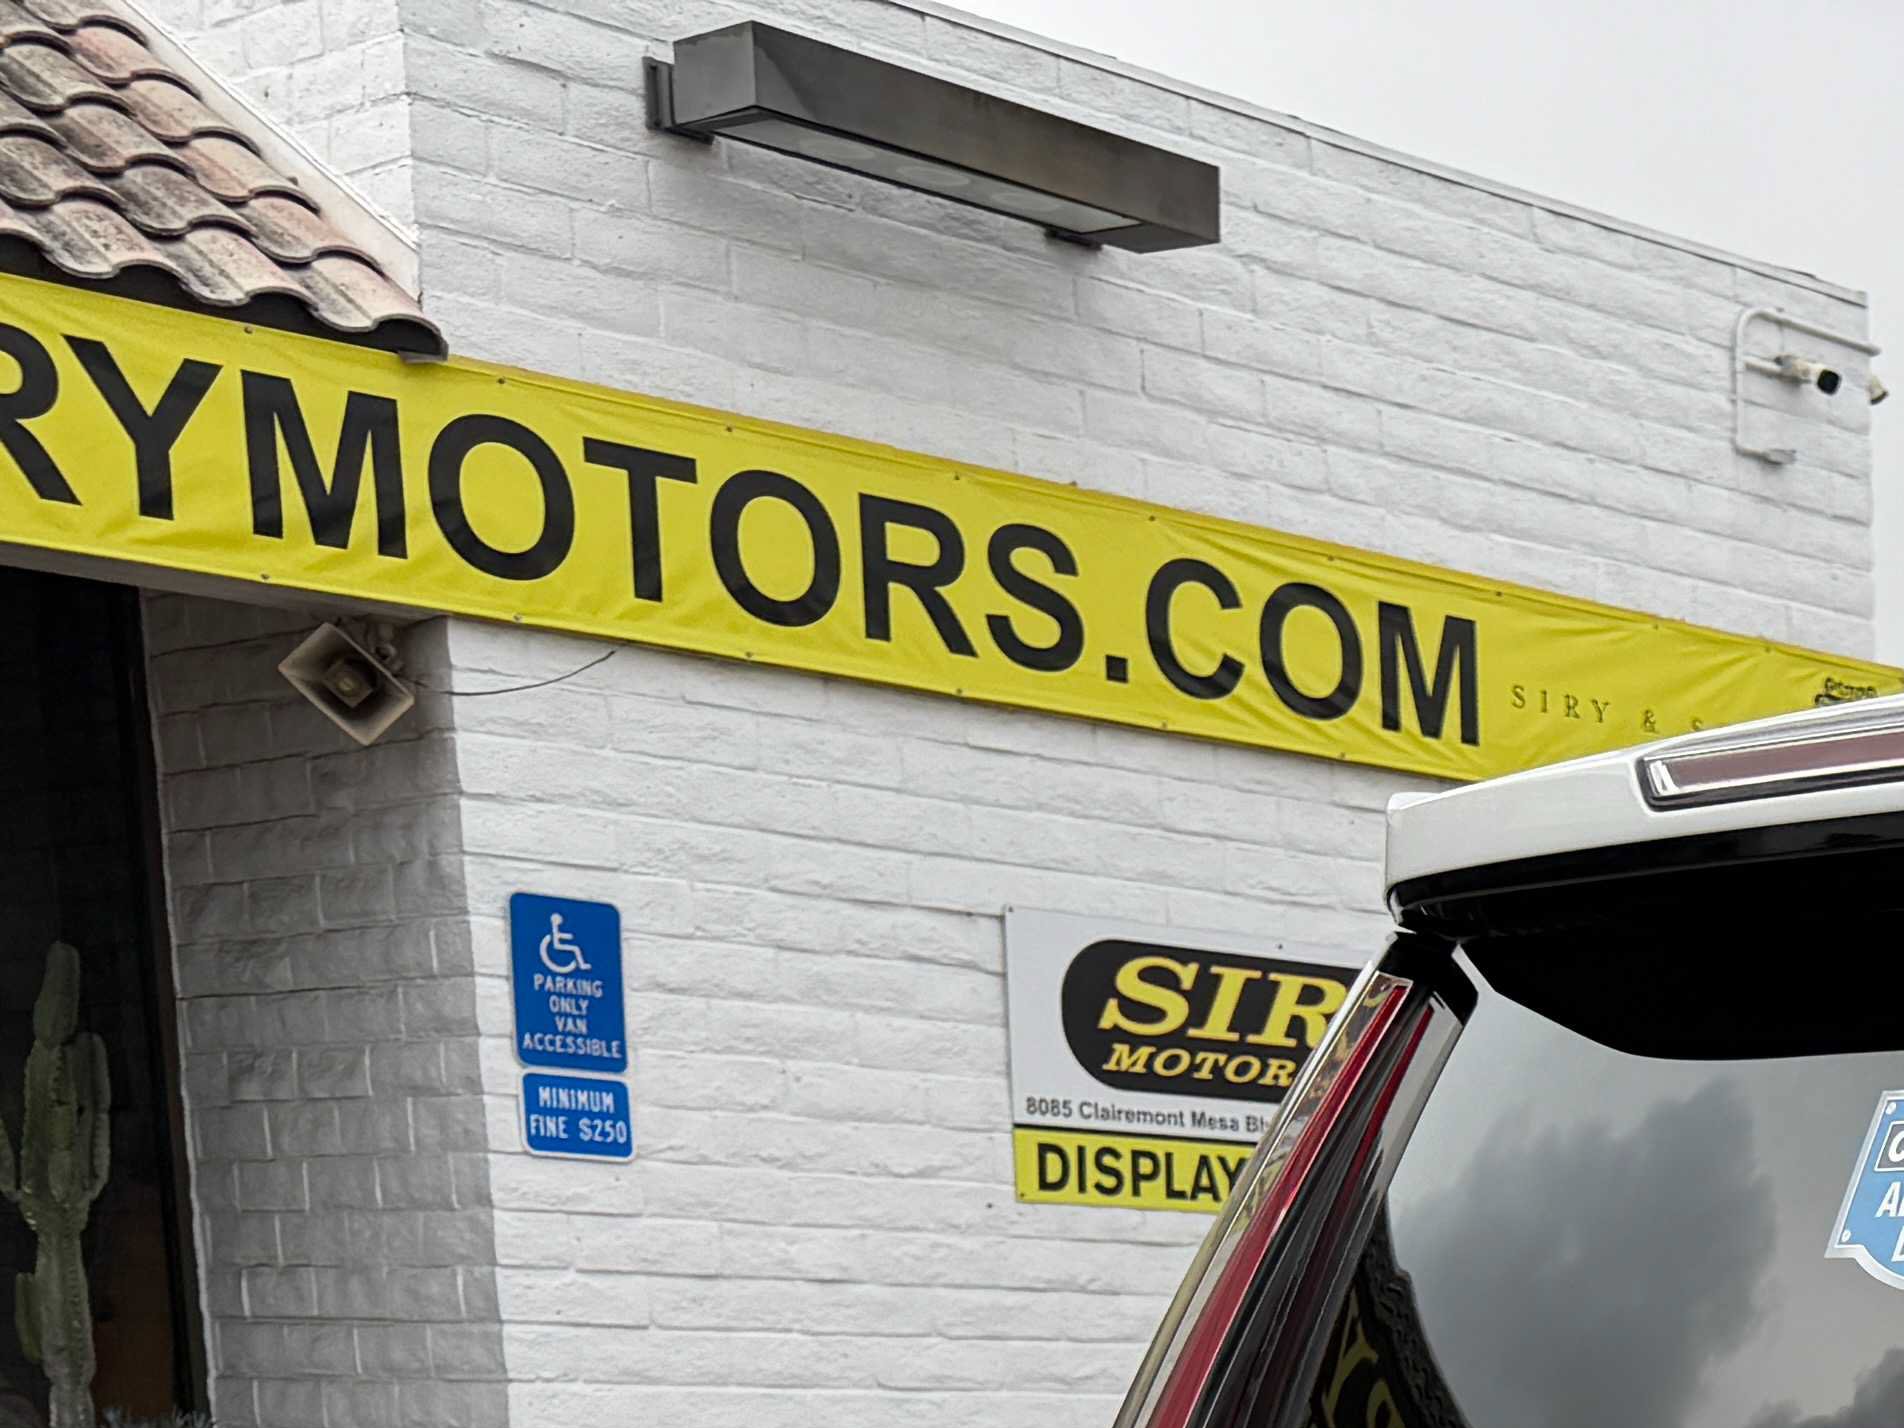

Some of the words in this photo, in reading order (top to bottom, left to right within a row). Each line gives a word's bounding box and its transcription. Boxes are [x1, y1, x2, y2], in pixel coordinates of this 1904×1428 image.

[1511, 685, 1611, 724] SIRY
[1643, 708, 1658, 734] &
[534, 973, 604, 998] PARKING
[548, 994, 590, 1016] ONLY
[555, 1015, 588, 1036] VAN
[522, 1032, 623, 1059] ACCESSIBLE
[538, 1085, 616, 1114] MINIMUM
[1026, 1096, 1073, 1118] 8085
[1079, 1101, 1185, 1128] Clairemont
[1191, 1110, 1240, 1132] Mesa
[529, 1114, 569, 1139] FINE
[578, 1117, 628, 1144] $250
[1037, 1142, 1250, 1203] DISPLAY
